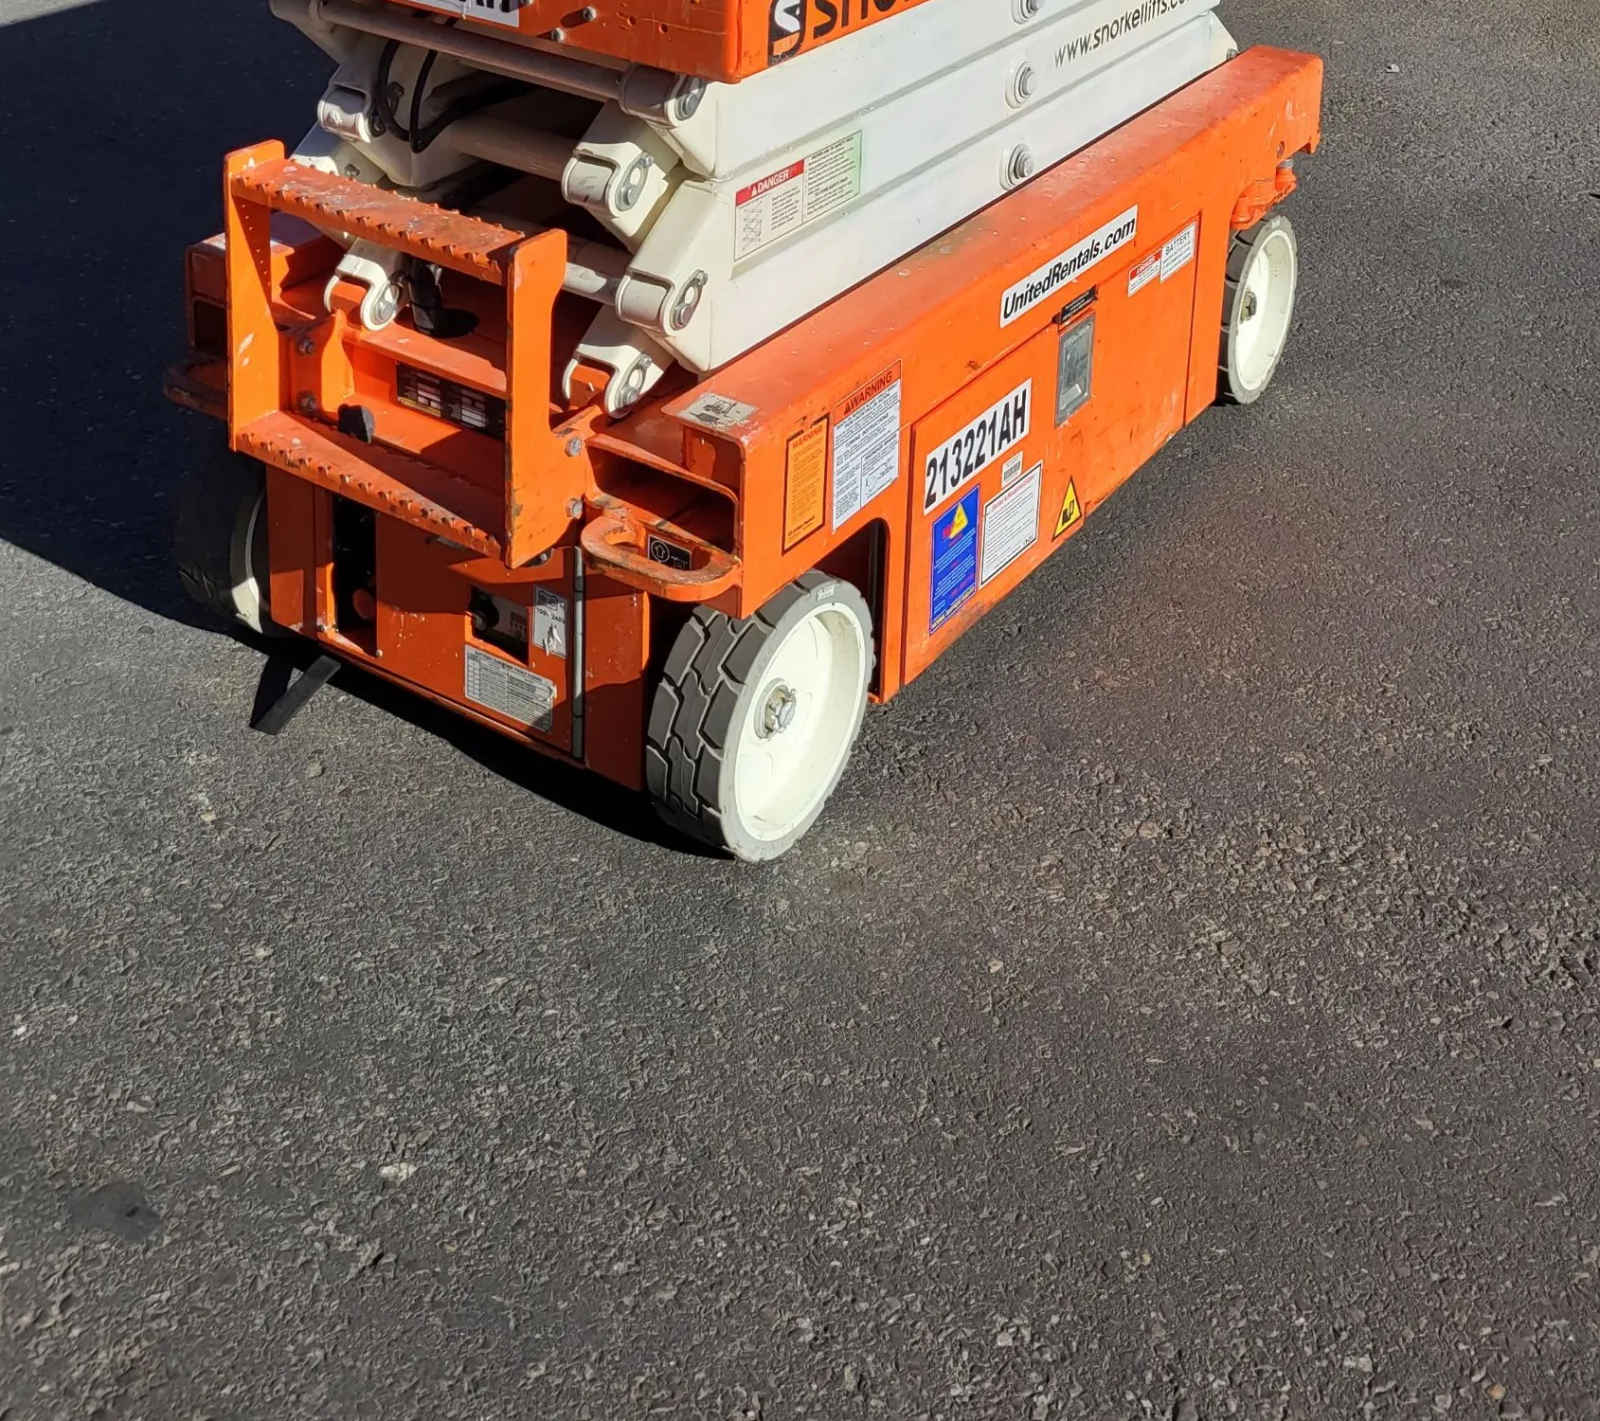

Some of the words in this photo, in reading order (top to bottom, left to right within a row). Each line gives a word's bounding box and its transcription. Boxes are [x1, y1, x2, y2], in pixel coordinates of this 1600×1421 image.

[757, 170, 790, 192] DANGER
[1164, 230, 1191, 256] BATTERY
[1002, 217, 1136, 320] UnitedRentals.com
[850, 370, 892, 410] WARNING
[924, 387, 1027, 510] 213221AH
